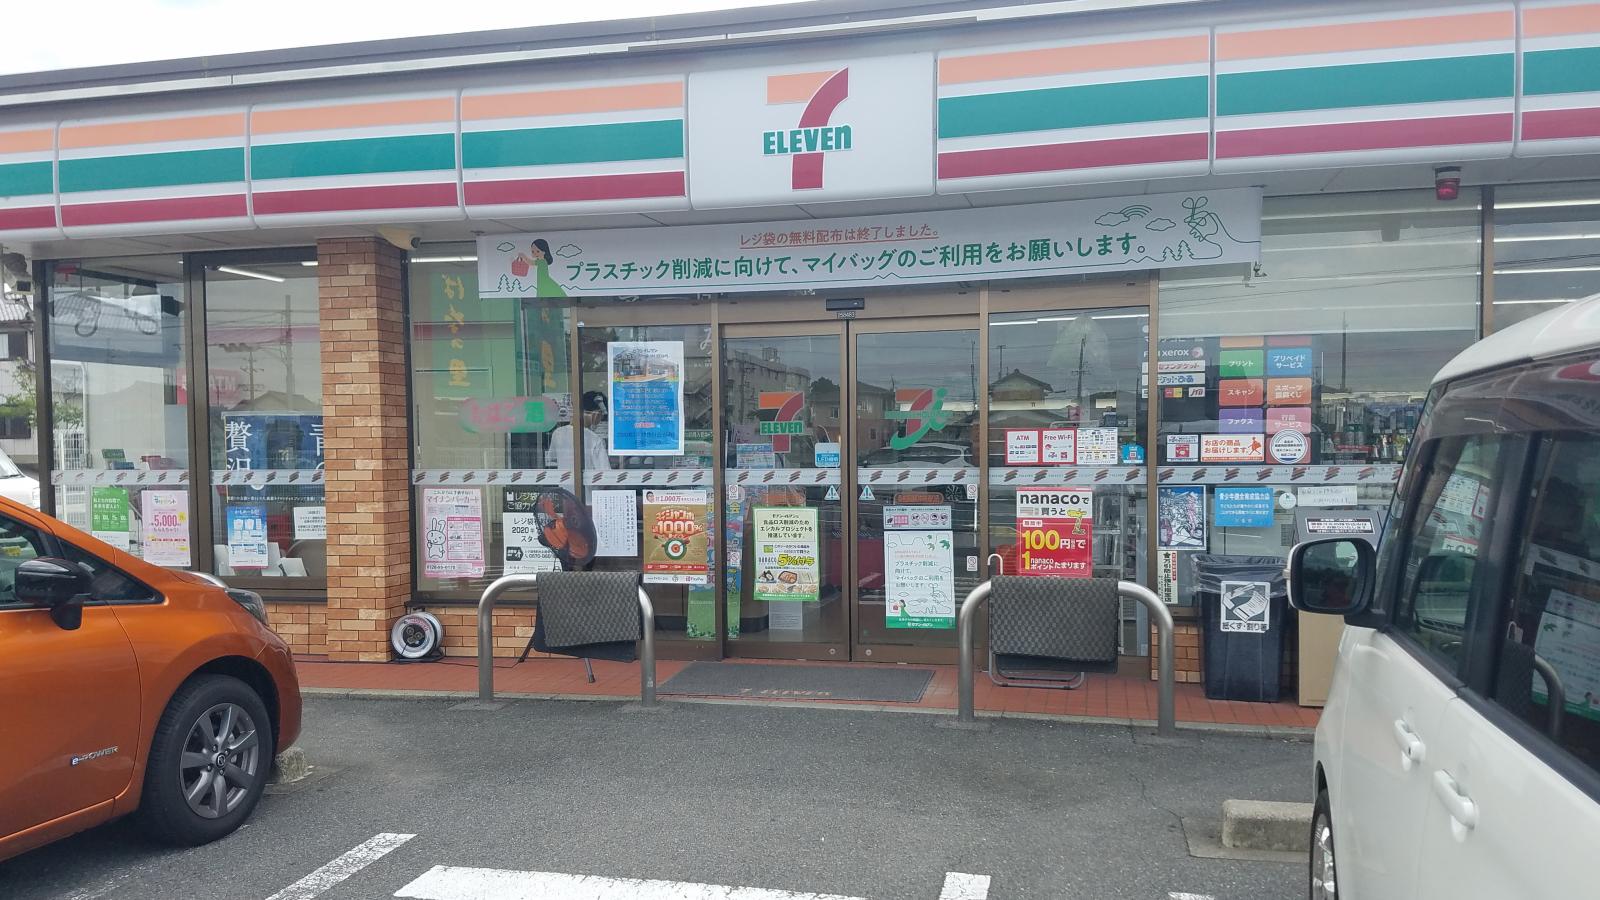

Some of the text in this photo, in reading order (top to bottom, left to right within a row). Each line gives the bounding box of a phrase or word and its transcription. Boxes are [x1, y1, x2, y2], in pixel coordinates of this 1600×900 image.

[740, 223, 940, 247] レジ袋の無料配布は終了しました。
[566, 232, 1145, 281] プラスチック削減に向けて、マイバッグのご利用をお願いします。
[1157, 375, 1194, 383] ケットぴあ
[1041, 507, 1066, 516] 買うと
